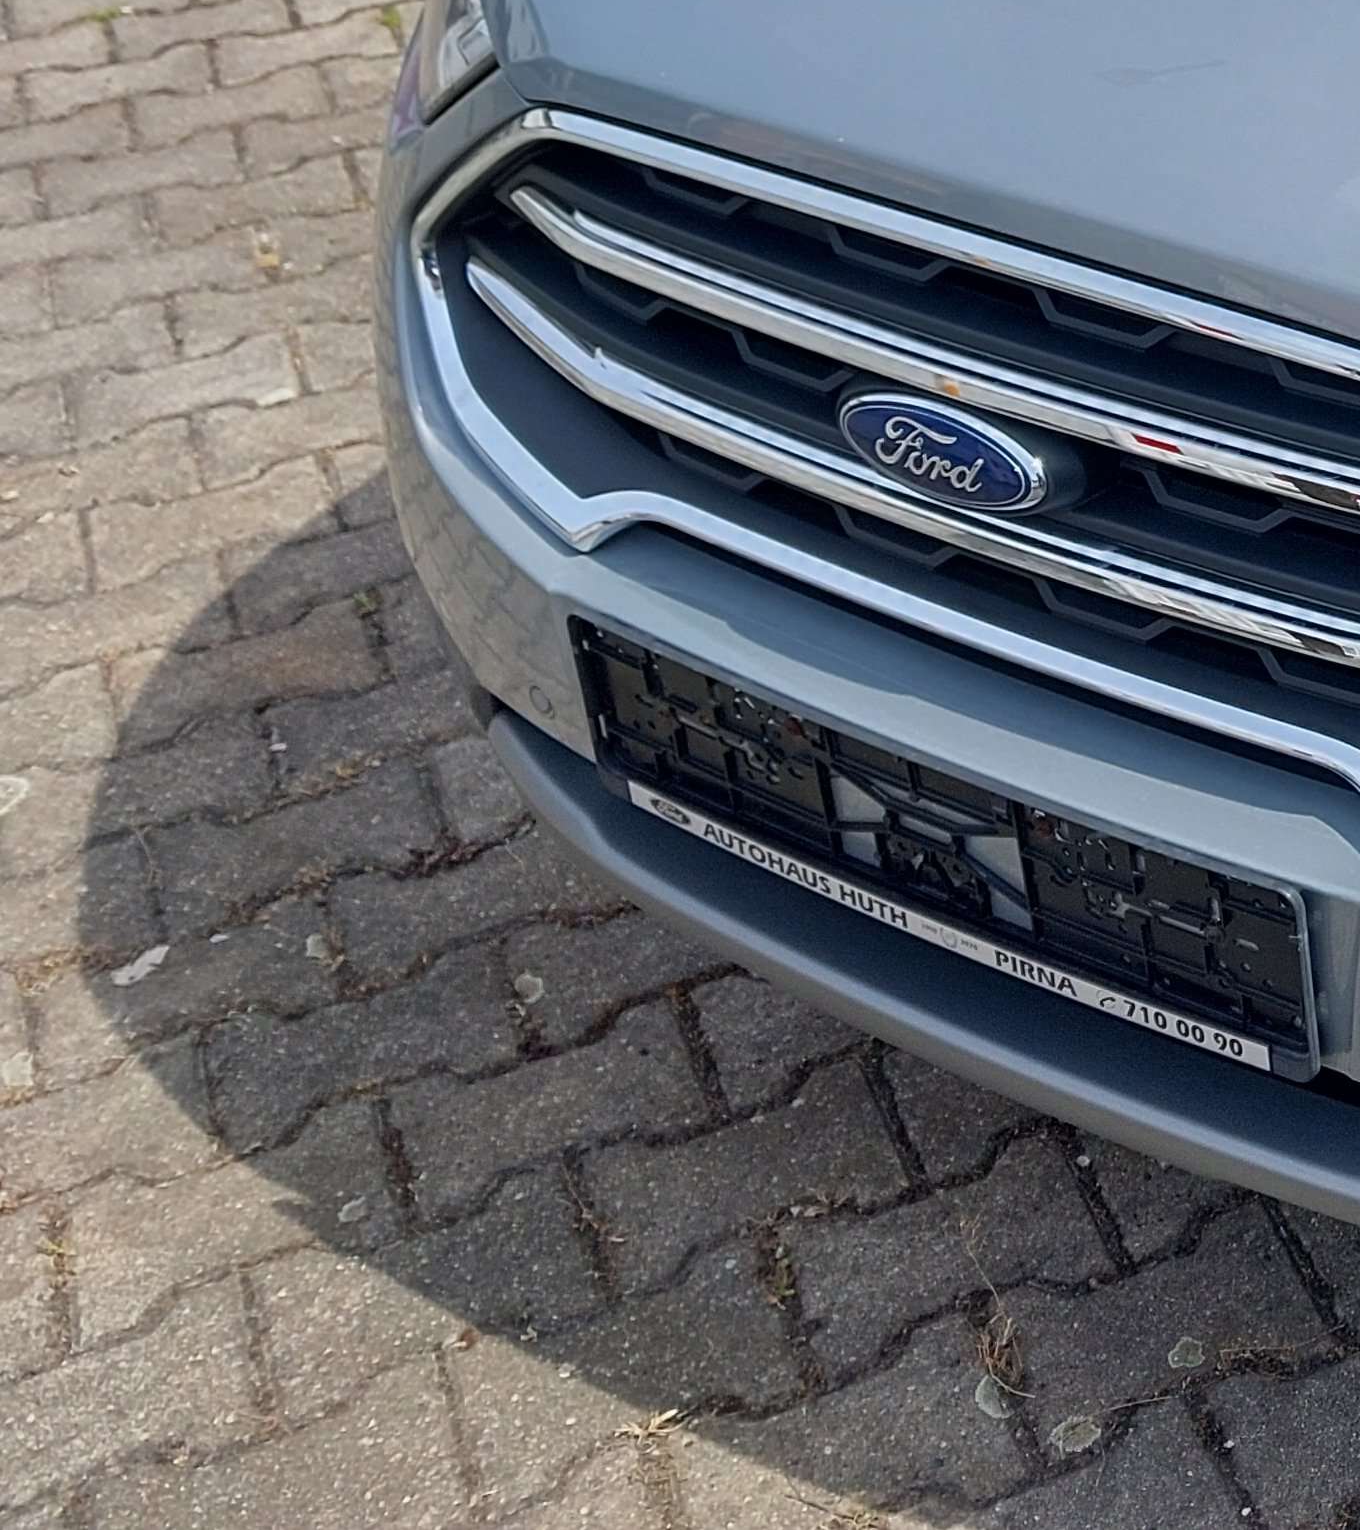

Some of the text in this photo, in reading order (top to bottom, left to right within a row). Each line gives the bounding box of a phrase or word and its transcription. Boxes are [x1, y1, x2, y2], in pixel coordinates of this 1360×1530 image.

[874, 416, 984, 493] Ford
[702, 823, 832, 896] AUTOHAUS
[838, 884, 909, 929] HUTH
[993, 949, 1244, 1058] PIRNA 710 00 90
